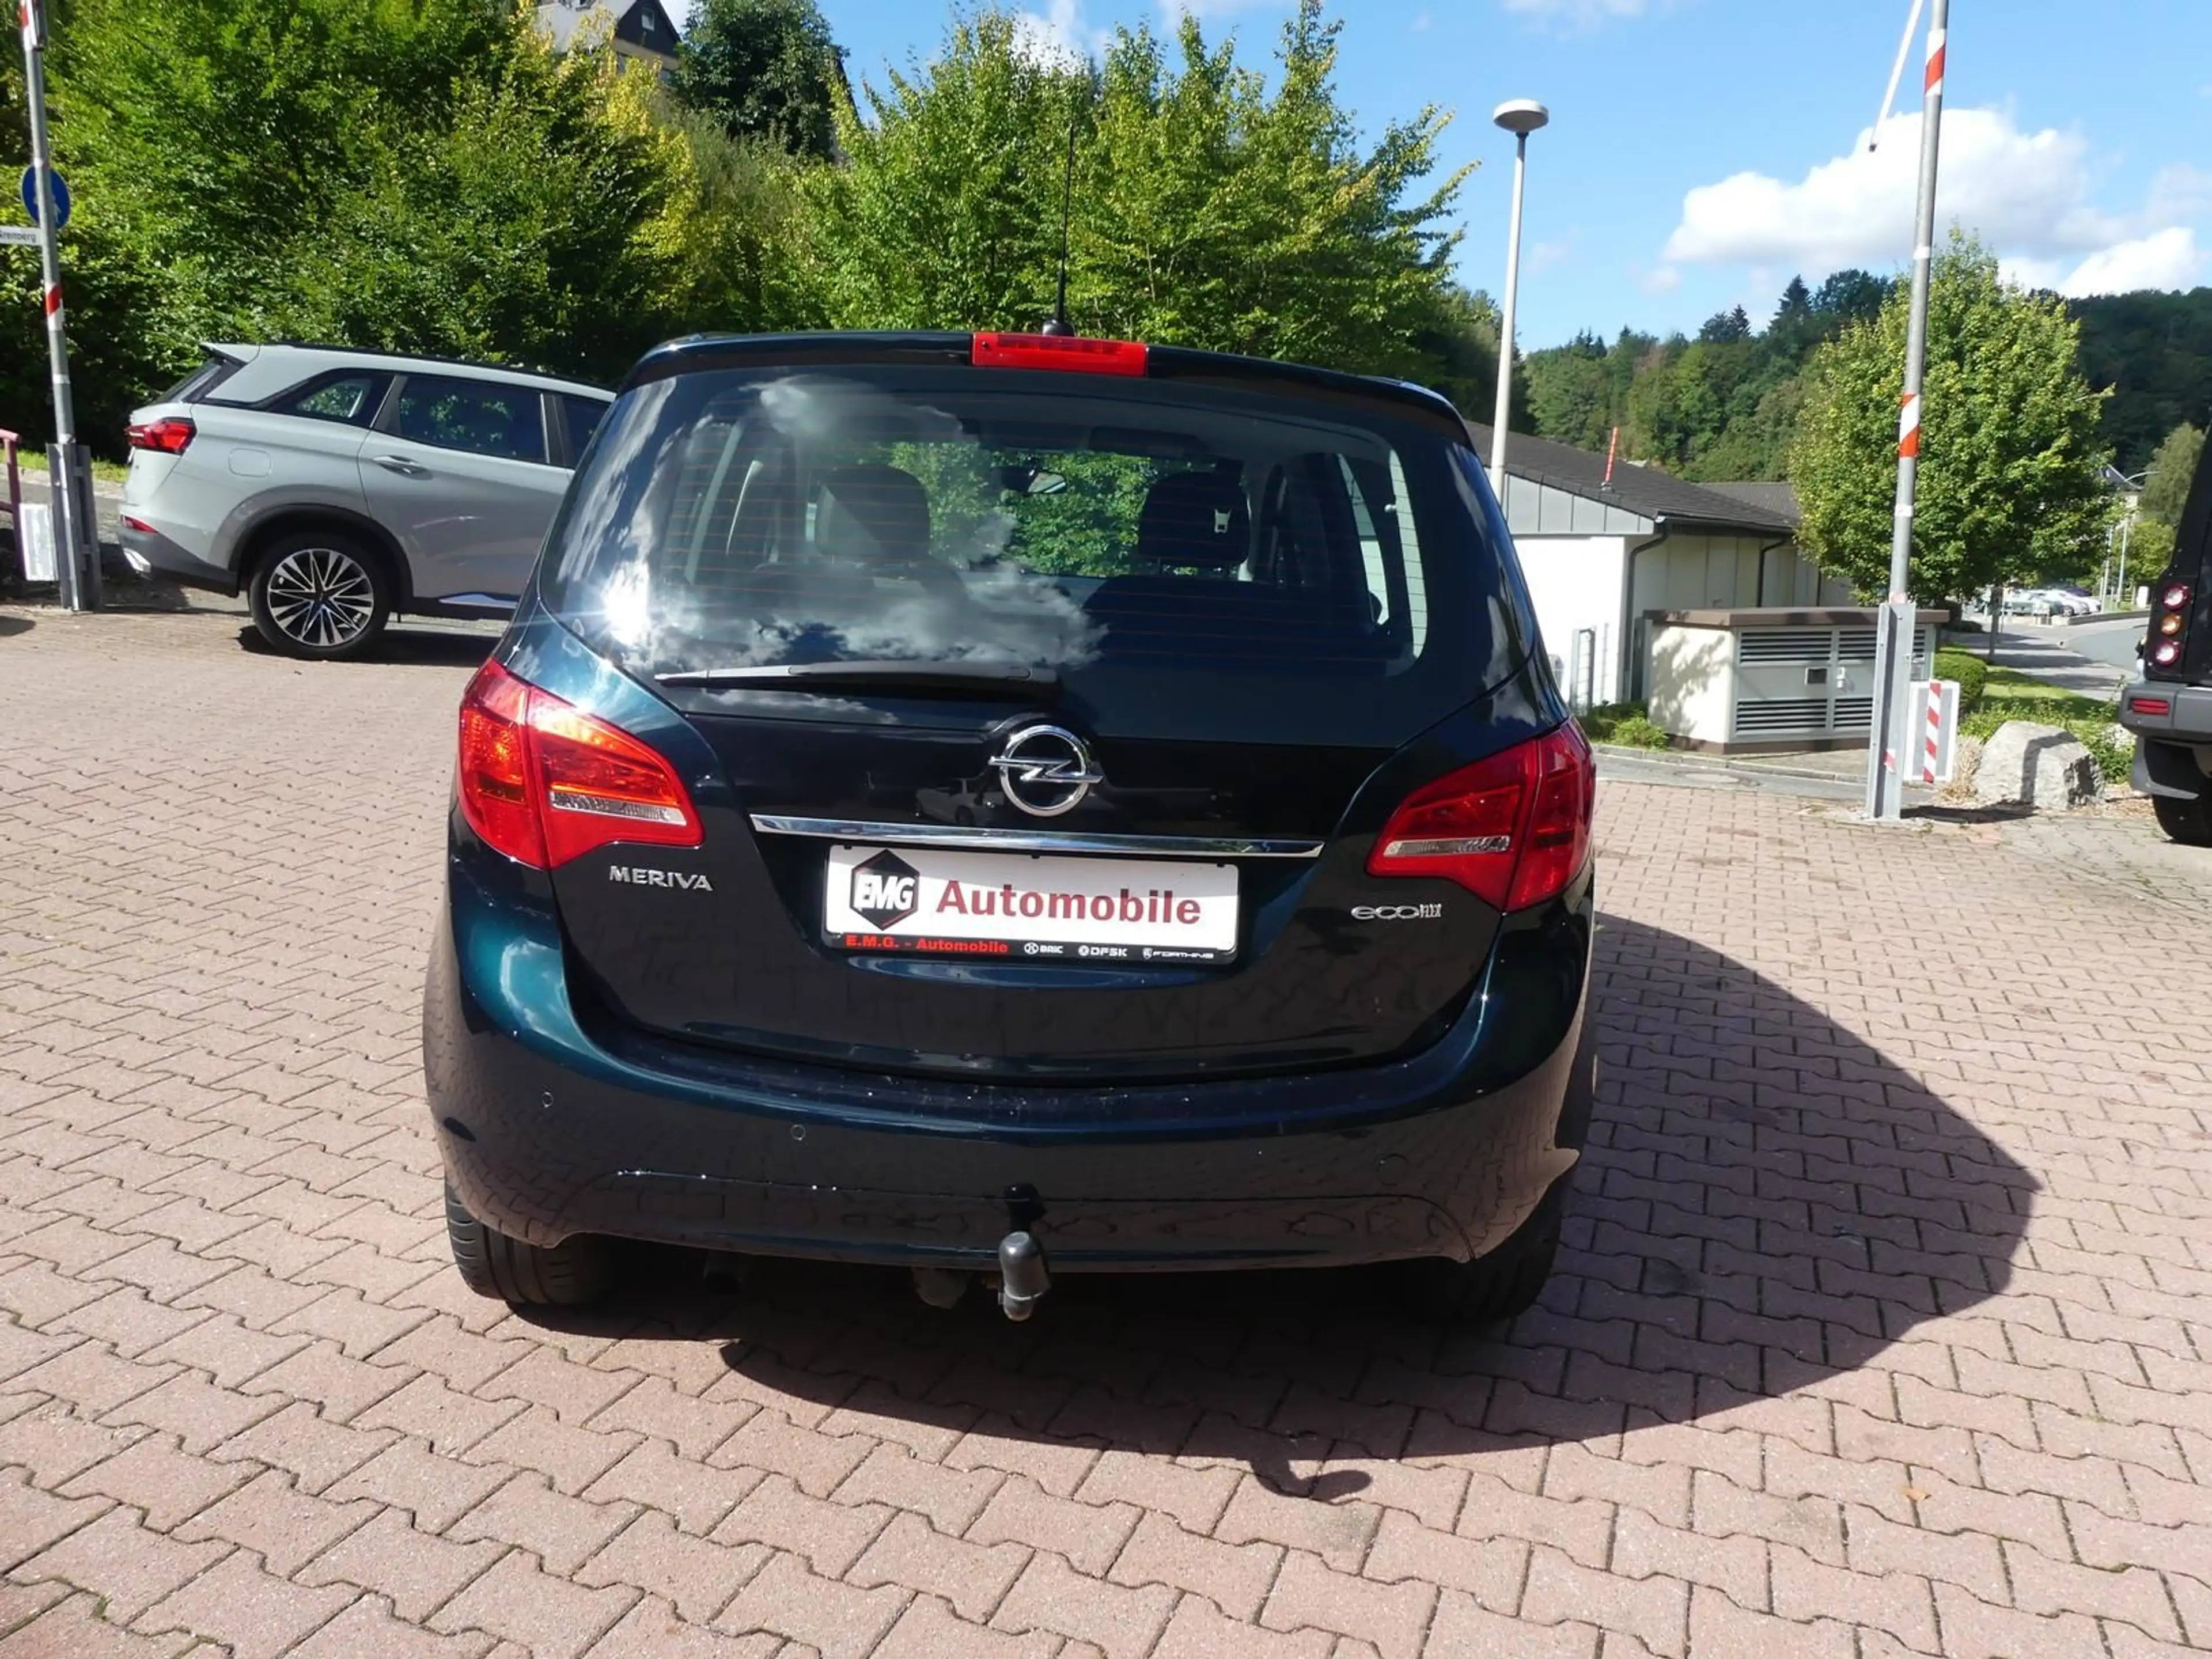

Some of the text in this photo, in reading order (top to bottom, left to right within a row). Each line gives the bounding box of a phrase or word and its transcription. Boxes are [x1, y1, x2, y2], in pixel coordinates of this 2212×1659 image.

[609, 865, 713, 891] MERIVA
[854, 874, 916, 911] EMG
[936, 880, 1201, 925] Automobile
[845, 934, 899, 949] E.M.G.
[916, 938, 1008, 953] Automobile
[1090, 946, 1128, 957] DFSK
